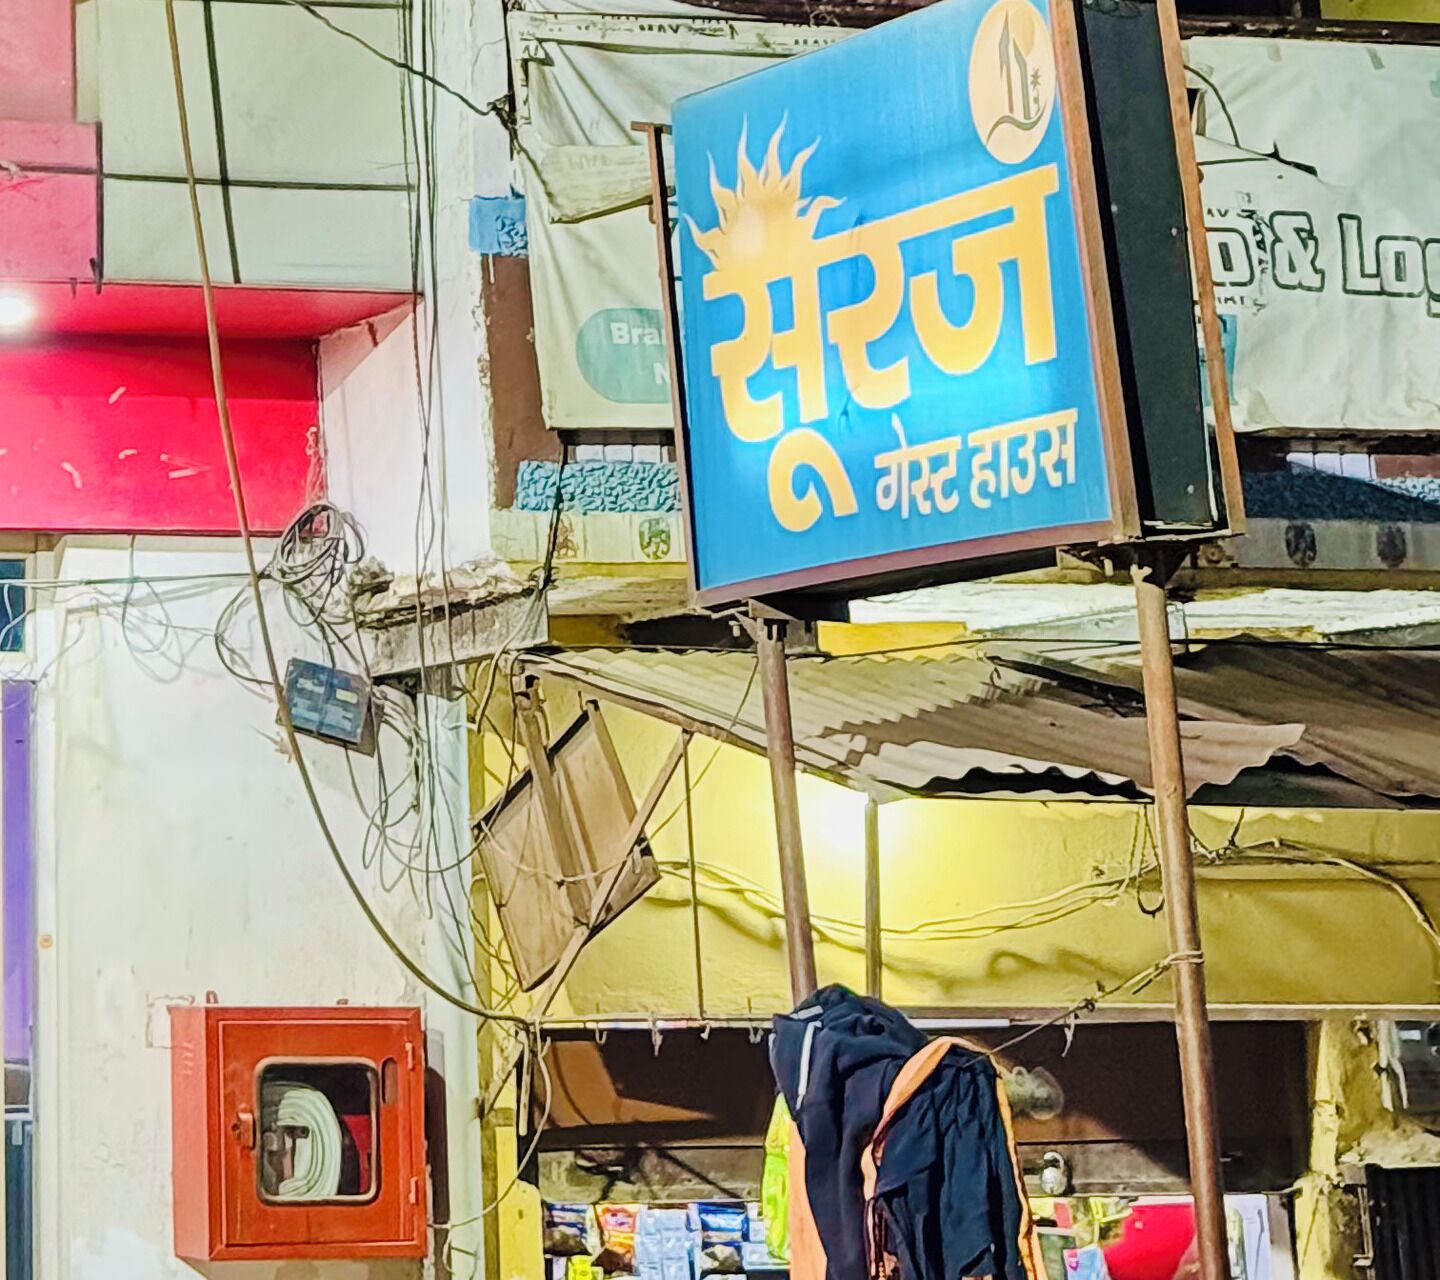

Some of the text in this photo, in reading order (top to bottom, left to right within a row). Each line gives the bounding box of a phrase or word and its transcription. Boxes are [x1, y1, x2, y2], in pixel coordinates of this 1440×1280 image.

[610, 322, 667, 346] Bra
[703, 162, 1060, 533] सूरज
[874, 407, 1079, 520] गेस्ट हाउस
